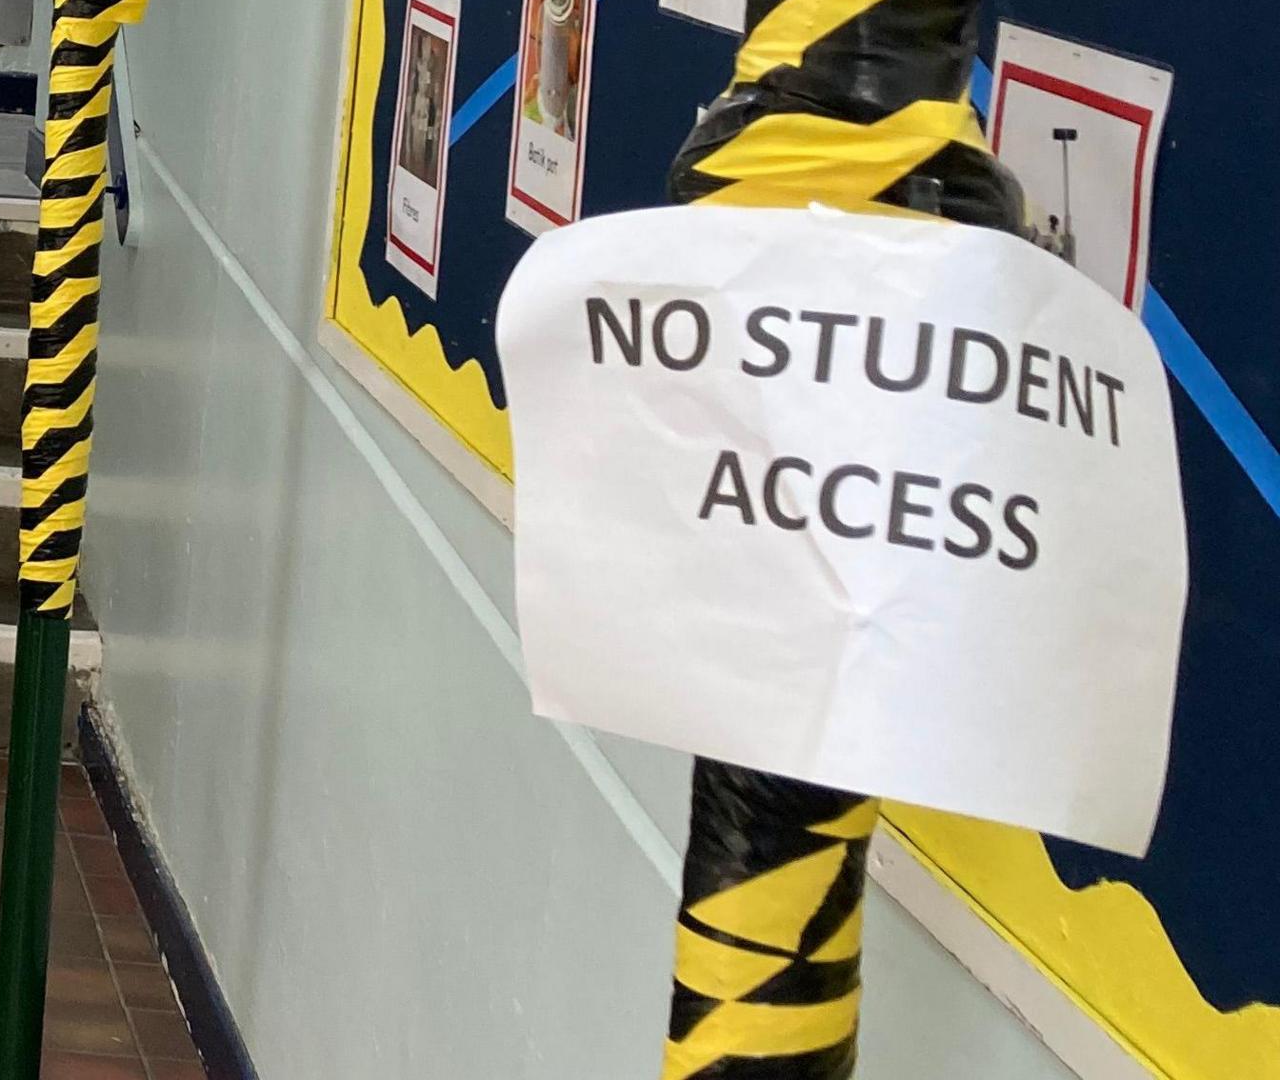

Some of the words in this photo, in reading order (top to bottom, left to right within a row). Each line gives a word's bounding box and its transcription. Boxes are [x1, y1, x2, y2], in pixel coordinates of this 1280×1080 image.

[528, 141, 546, 167] Batik
[546, 158, 559, 176] pot
[586, 298, 711, 371] NO
[740, 305, 1125, 447] STUDENT
[698, 450, 1040, 570] ACCESS
